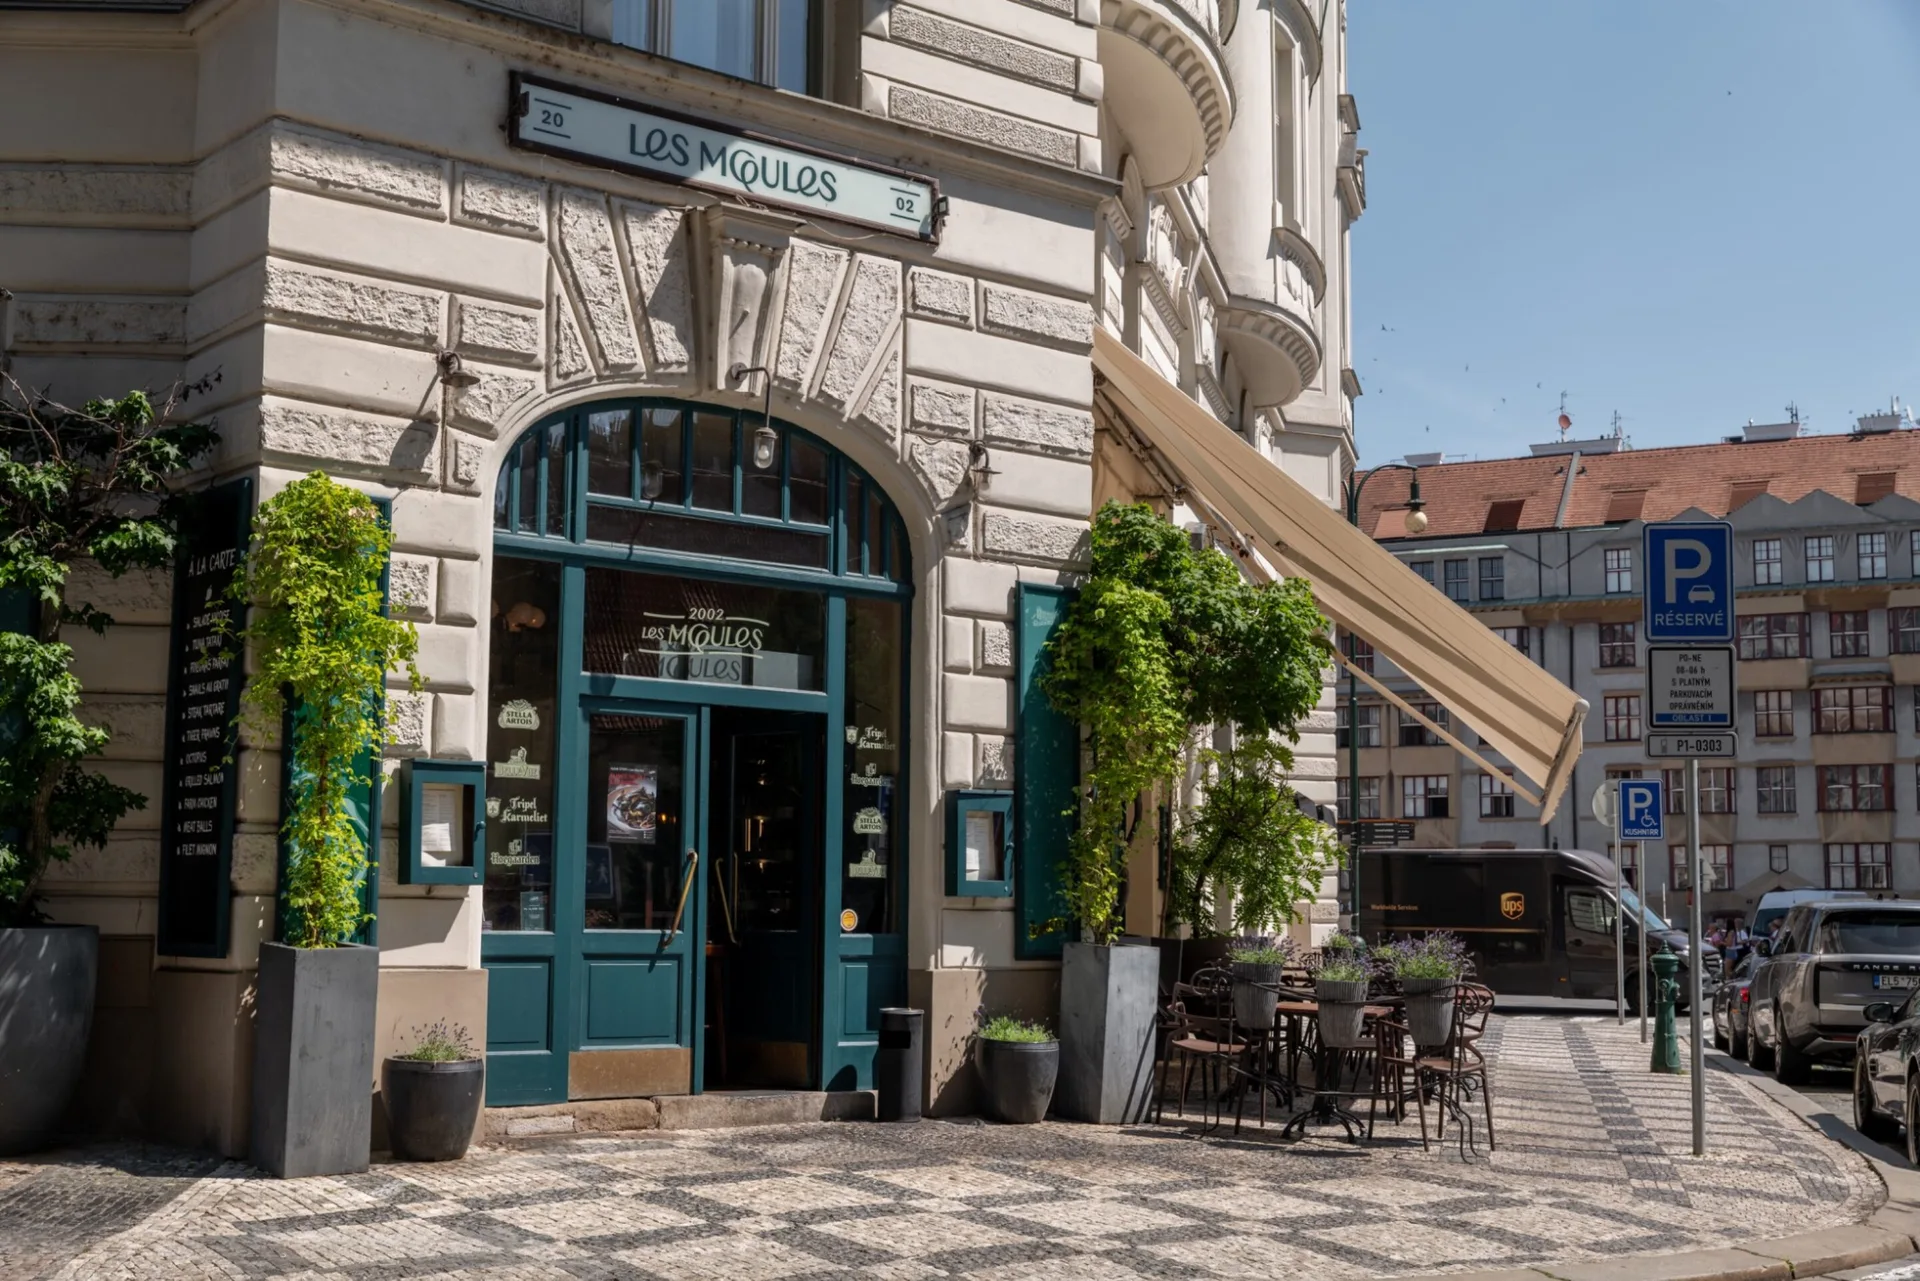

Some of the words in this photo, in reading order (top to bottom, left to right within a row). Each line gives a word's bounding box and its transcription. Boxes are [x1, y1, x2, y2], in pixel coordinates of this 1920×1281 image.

[541, 109, 564, 128] 20
[896, 196, 915, 214] 02
[196, 556, 207, 575] LA
[209, 548, 236, 572] CARTE
[1664, 539, 1712, 604] P
[688, 607, 724, 621] 2002
[1655, 610, 1724, 626] RÉSERVÉ
[1679, 654, 1702, 662] PO-NE
[1676, 666, 1698, 674] 08-06
[1701, 666, 1706, 674] h
[1671, 678, 1676, 686] S
[1679, 677, 1711, 686] PLATNÝM
[1669, 689, 1713, 698] PARKOVACÍM
[187, 706, 203, 719] STEAK
[203, 702, 225, 717] TARTARE
[1669, 701, 1714, 710] OPRÁVNĚNÍM
[506, 711, 532, 719] STELLA
[1671, 714, 1705, 722] OBLAST
[186, 729, 200, 742] TIGER
[201, 727, 220, 741] PRAWNS
[864, 725, 887, 740] Tripel
[857, 735, 896, 750] Karmeliet
[1677, 739, 1722, 752] P1-0303
[185, 751, 207, 765] OCTOPUS
[203, 772, 224, 786] SALMON
[509, 796, 537, 812] Tripel
[1629, 787, 1653, 821] P
[500, 807, 548, 823] Karmeliet
[183, 820, 196, 833] MEAT
[196, 820, 212, 832] BALLS
[182, 843, 195, 856] FILET
[196, 843, 217, 855] MIGNON
[490, 852, 541, 867] Hoegaarden
[1503, 900, 1522, 916] ups
